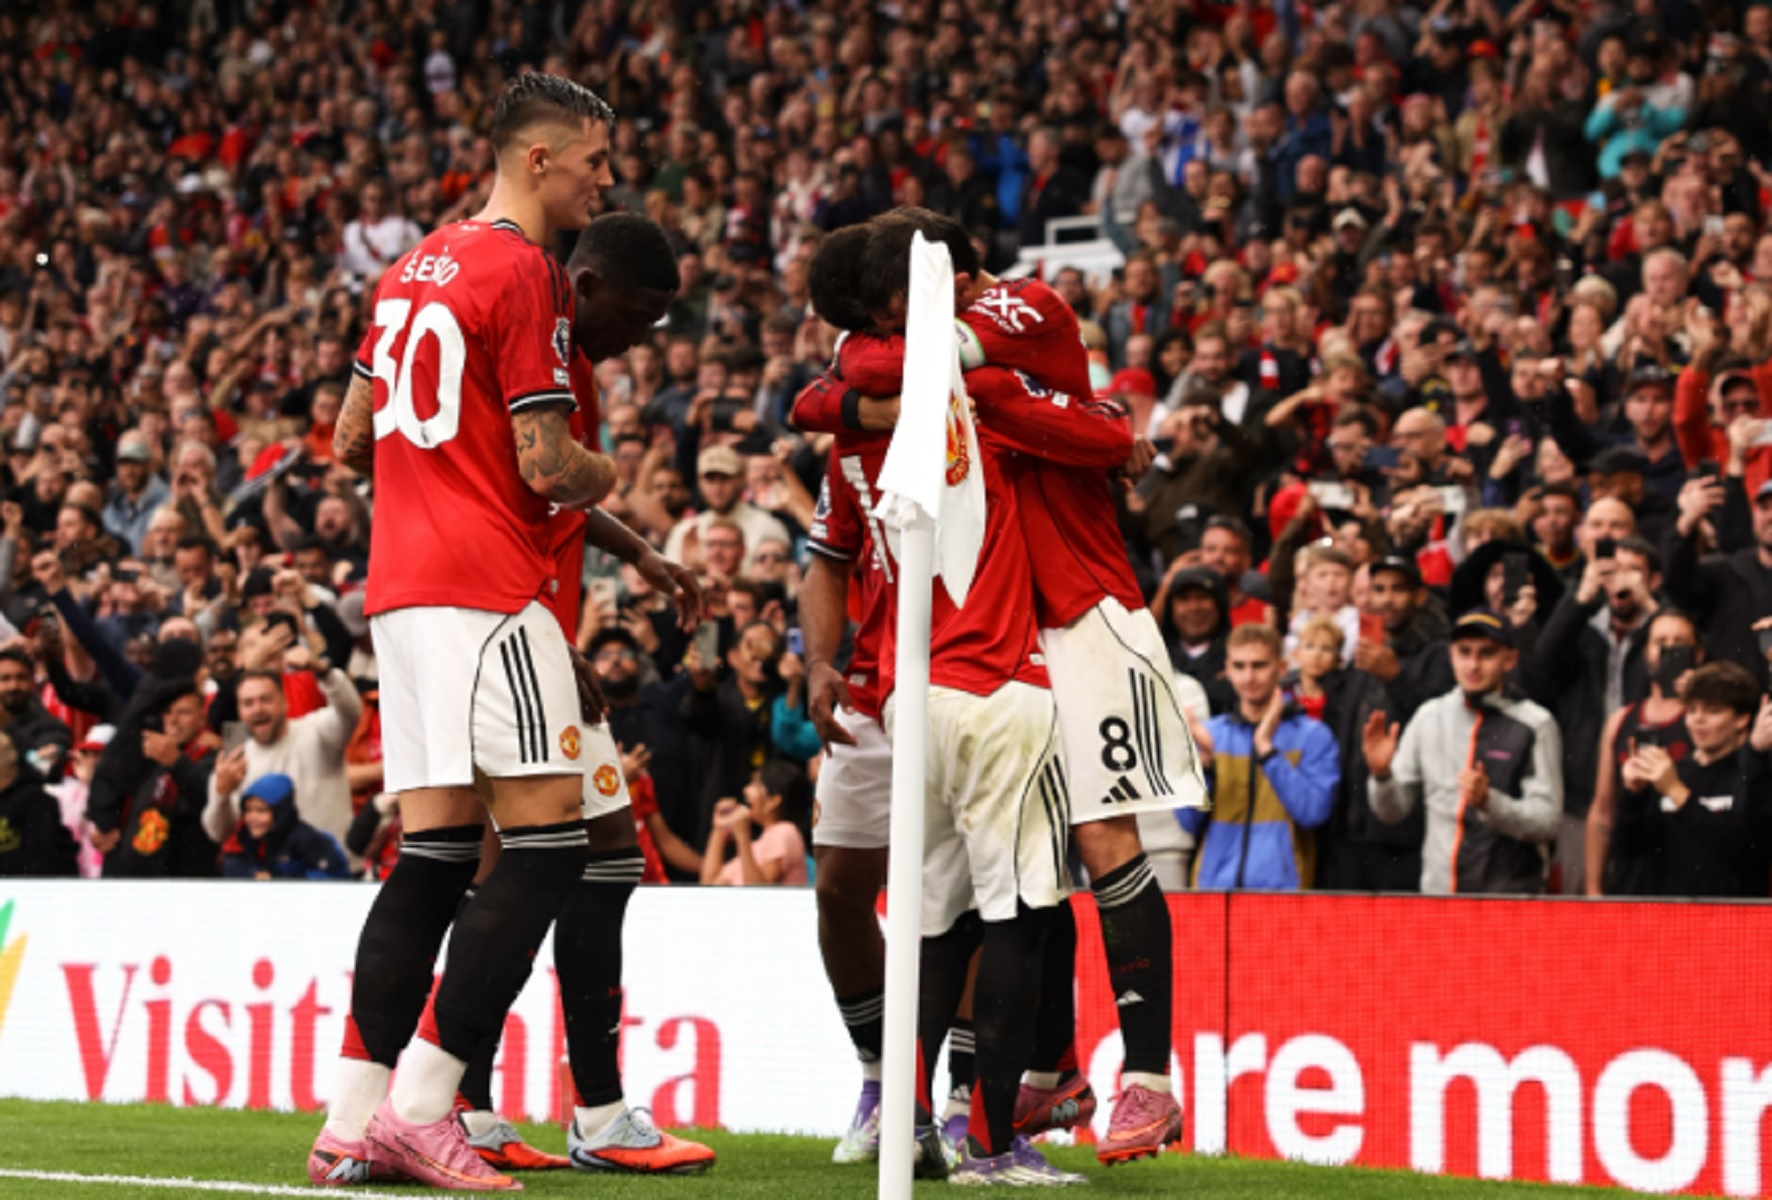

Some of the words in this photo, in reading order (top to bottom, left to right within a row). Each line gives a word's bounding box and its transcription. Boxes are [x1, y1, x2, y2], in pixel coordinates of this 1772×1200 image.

[372, 297, 467, 450] 30
[1098, 714, 1138, 773] 8
[58, 953, 332, 1113] Visit
